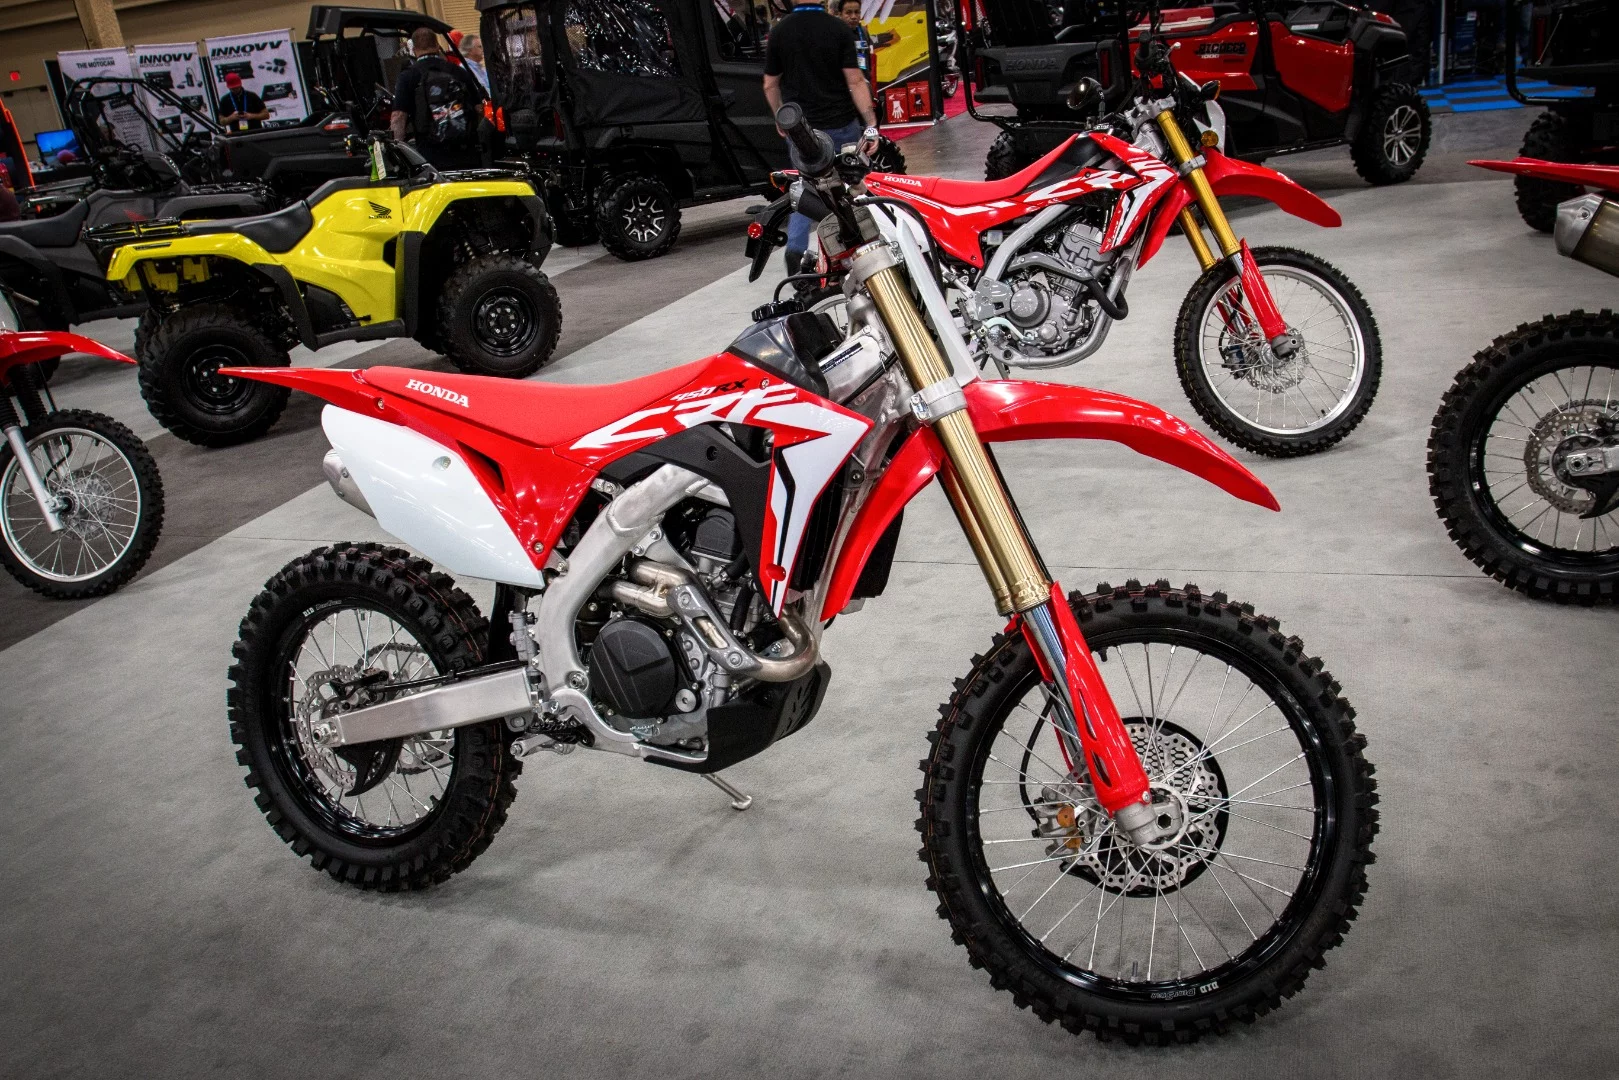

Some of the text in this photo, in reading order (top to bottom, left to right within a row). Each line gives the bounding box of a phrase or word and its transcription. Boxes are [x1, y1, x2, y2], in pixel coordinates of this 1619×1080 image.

[211, 40, 283, 57] INNOVV
[88, 60, 115, 68] MOTOCAM
[139, 52, 193, 64] INNOVV
[883, 175, 923, 187] HONDA
[405, 378, 470, 408] HONDA
